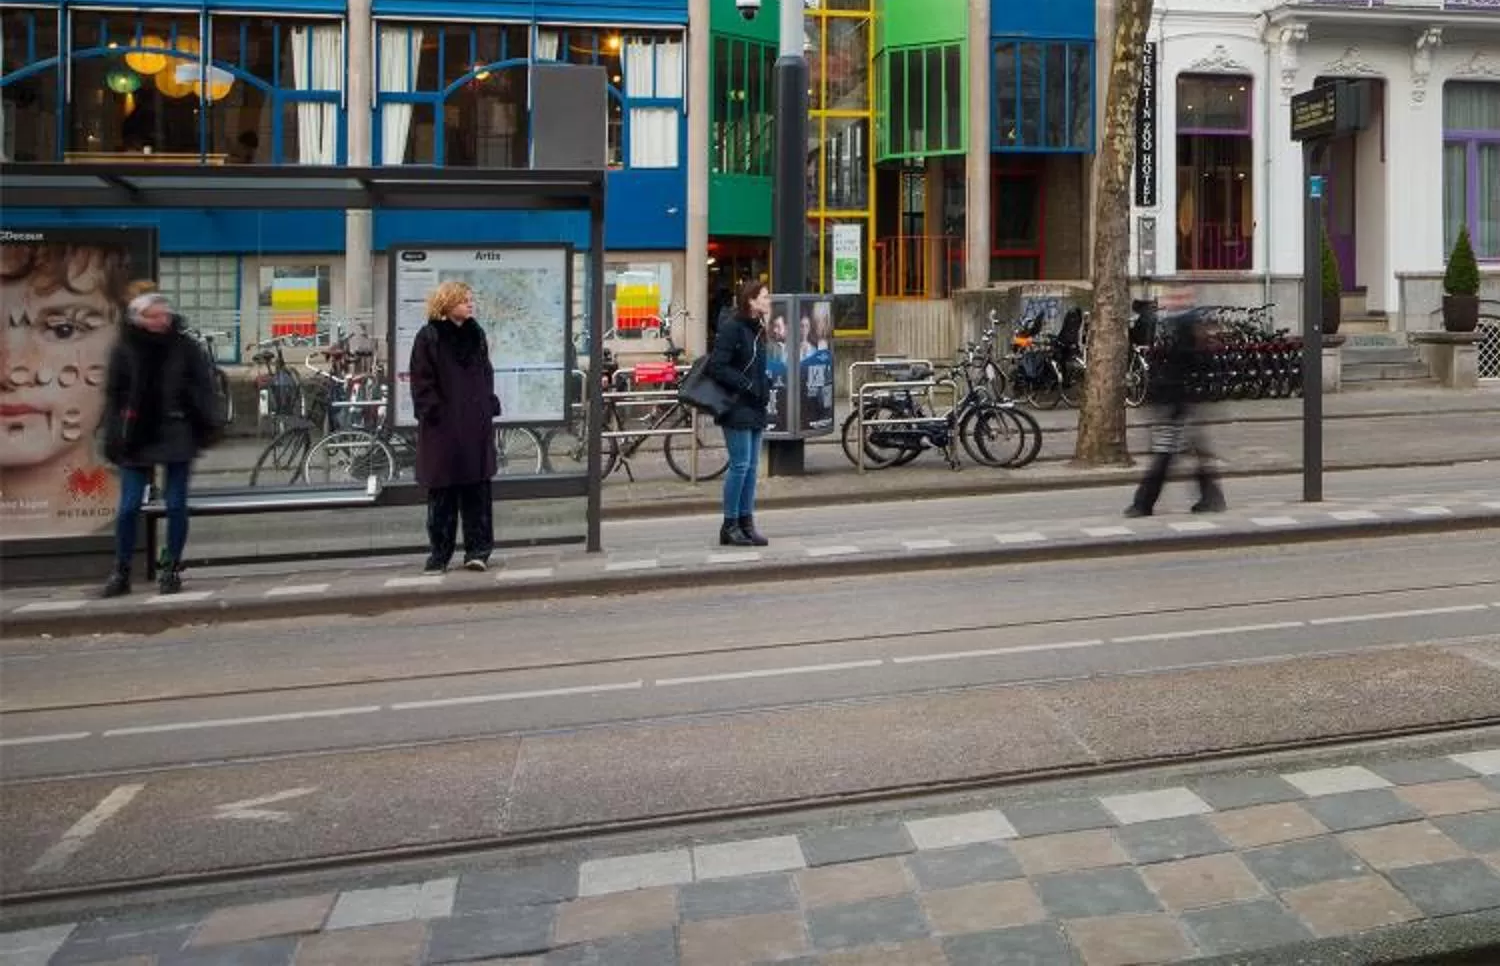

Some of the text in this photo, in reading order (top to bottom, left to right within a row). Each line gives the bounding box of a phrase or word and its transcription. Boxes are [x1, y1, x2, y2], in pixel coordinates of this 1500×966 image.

[1142, 42, 1153, 205] QUENTIN ZOO HOTEL
[476, 251, 501, 261] Artis
